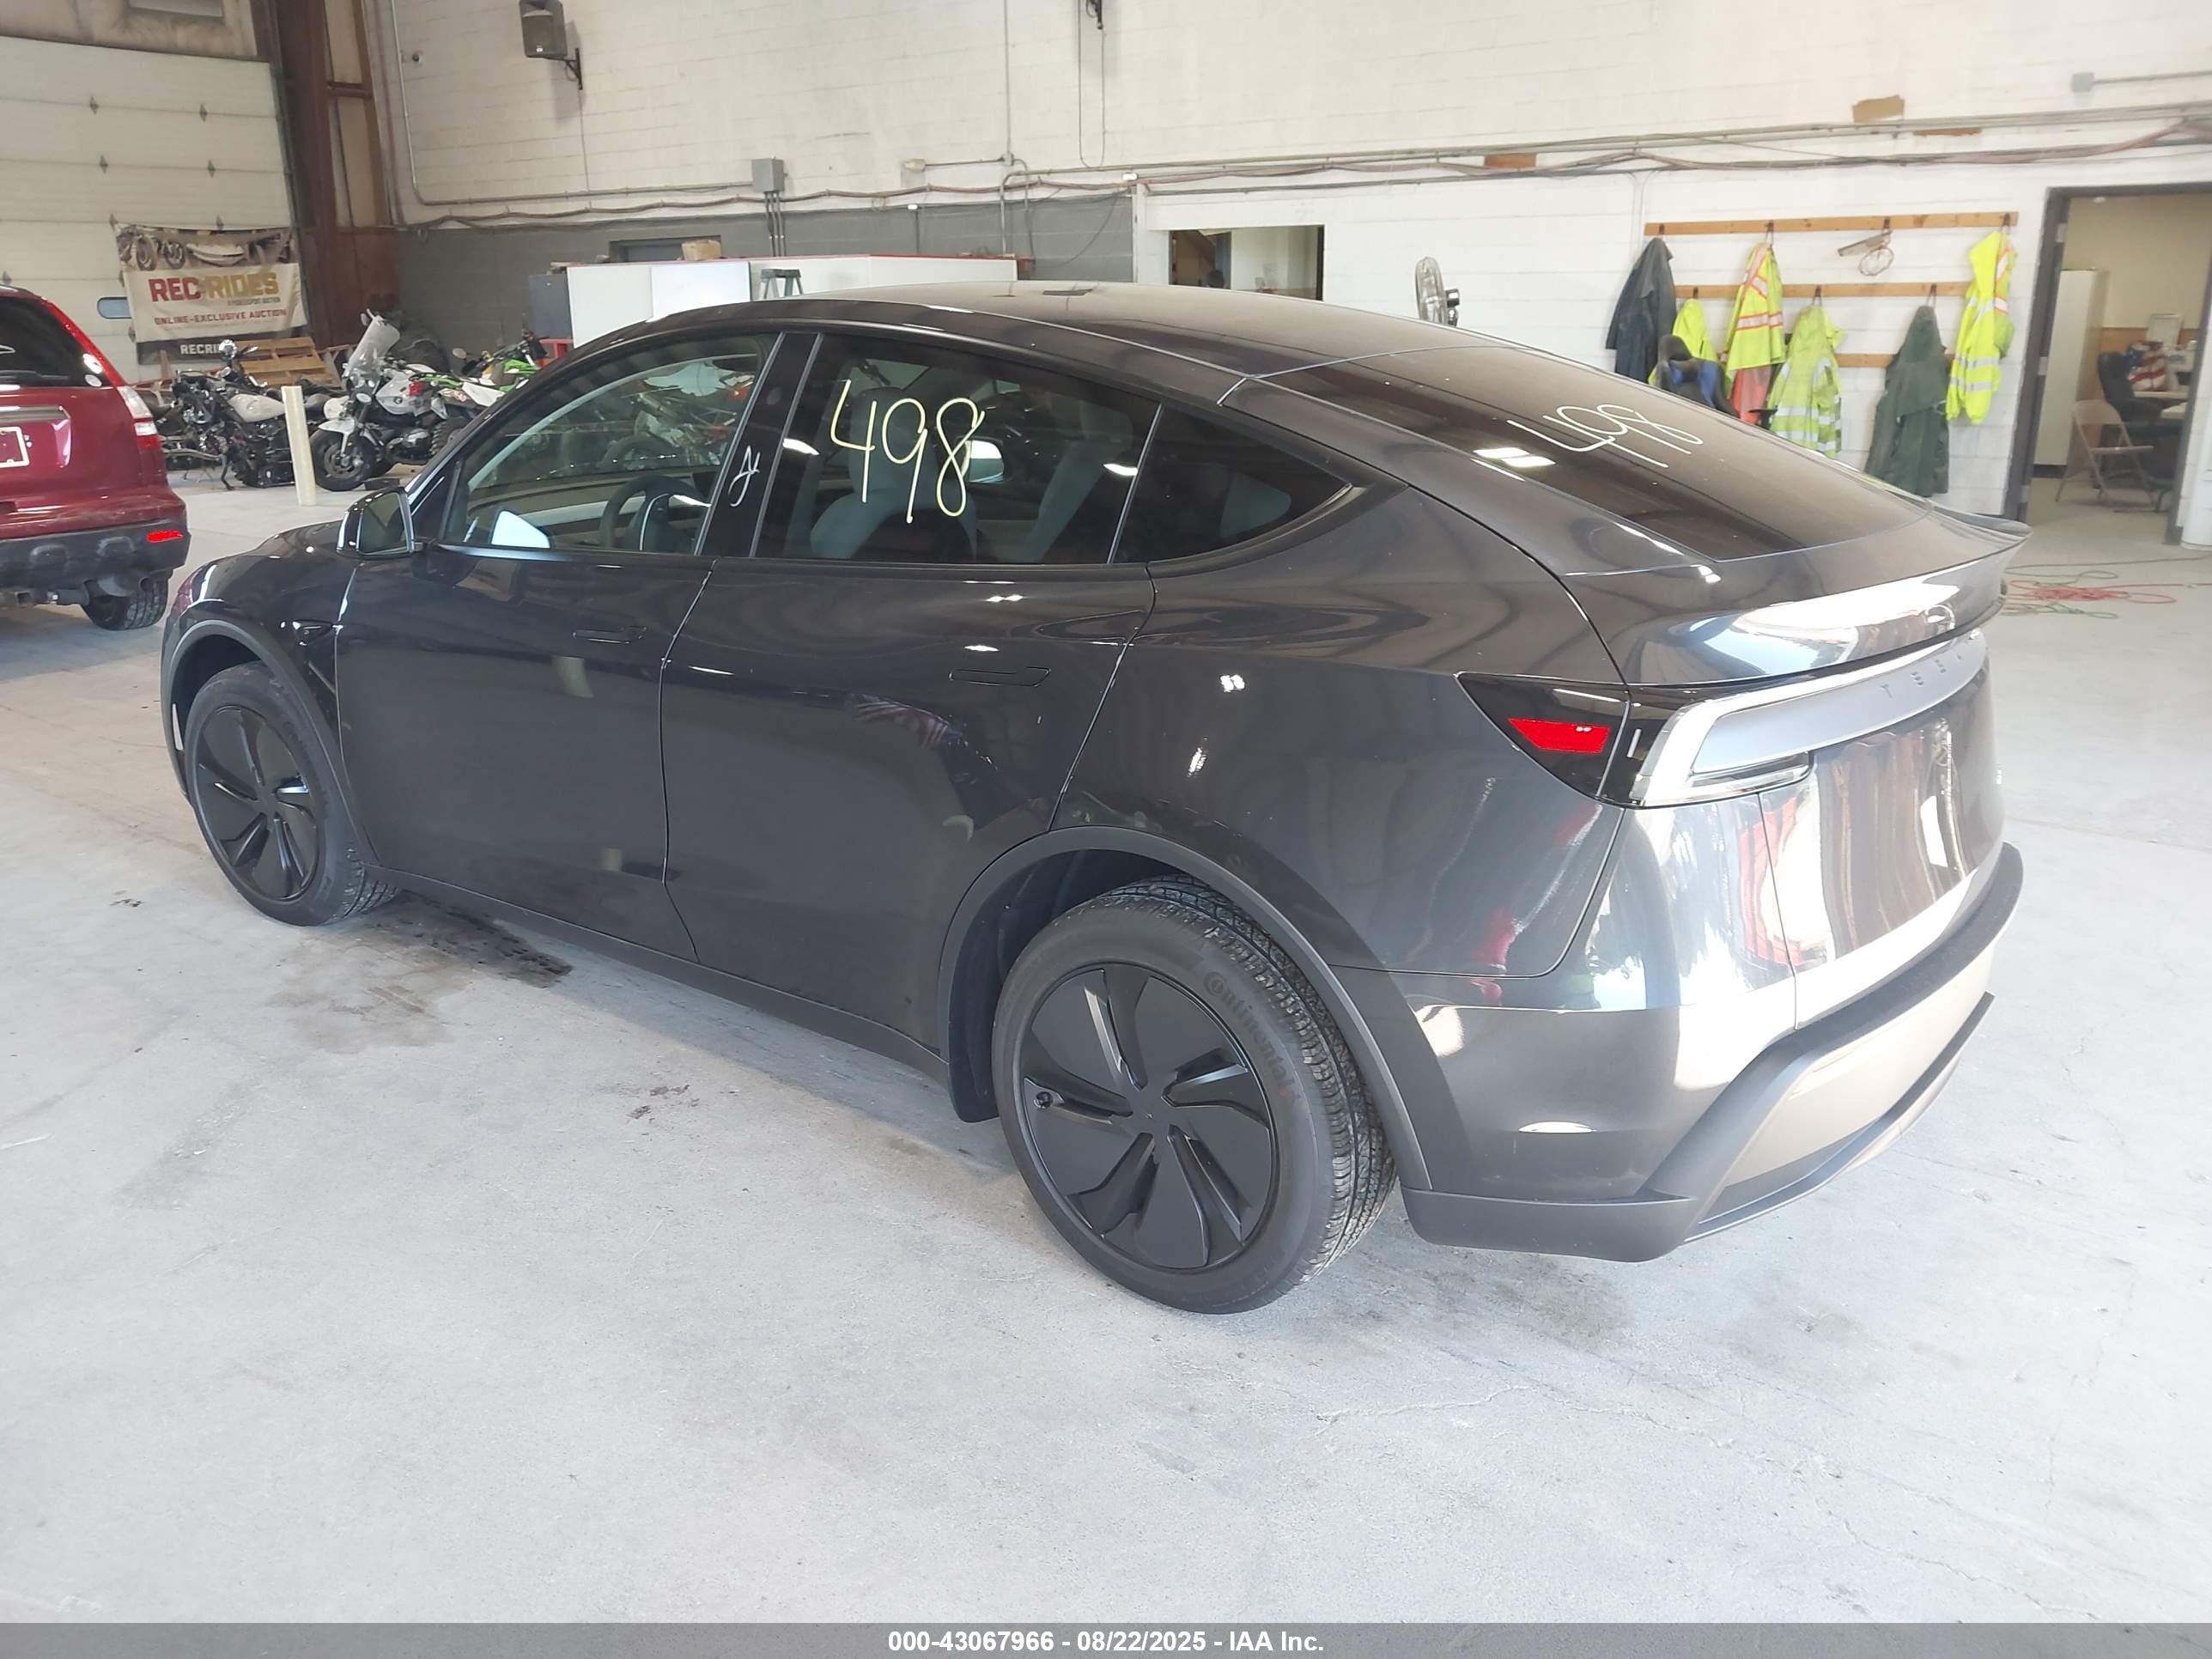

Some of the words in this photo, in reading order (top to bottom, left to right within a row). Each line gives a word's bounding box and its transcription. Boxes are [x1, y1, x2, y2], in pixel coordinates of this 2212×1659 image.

[149, 276, 201, 301] REC
[204, 272, 279, 299] RIDES
[154, 310, 246, 325] ONLINE-EXCLUSIVE
[249, 308, 288, 319] AUCTION
[830, 378, 985, 524] 498
